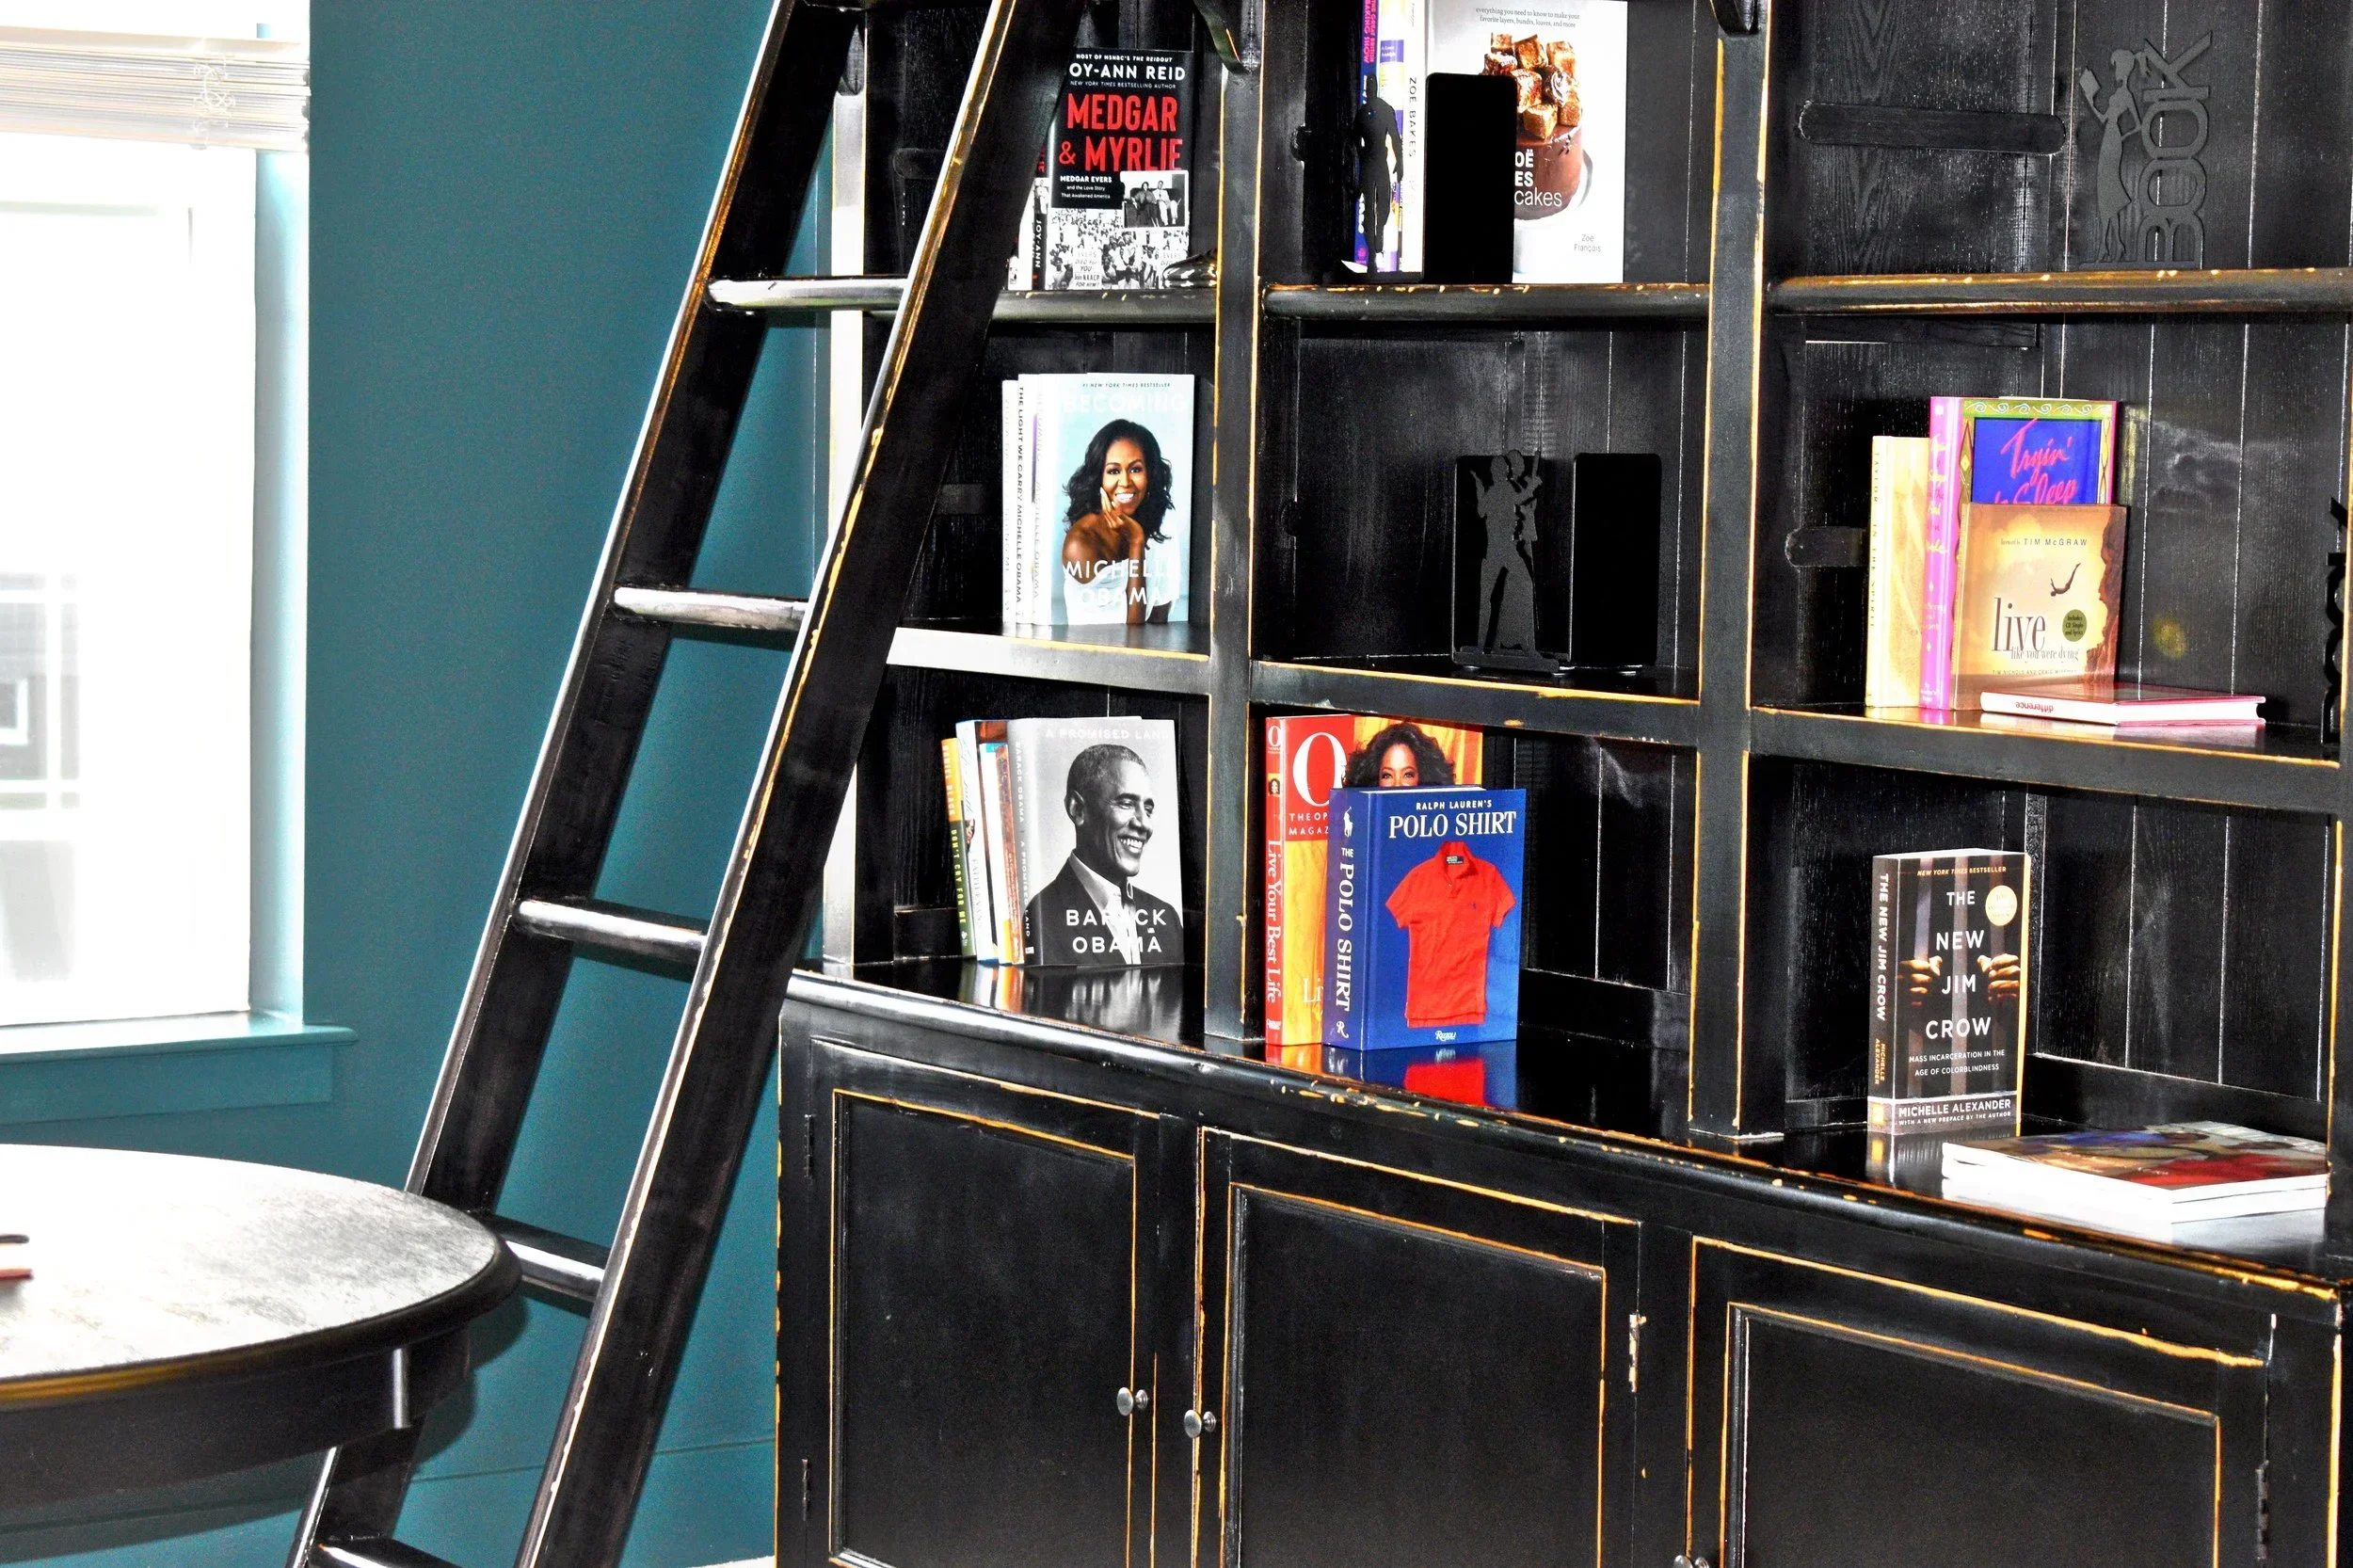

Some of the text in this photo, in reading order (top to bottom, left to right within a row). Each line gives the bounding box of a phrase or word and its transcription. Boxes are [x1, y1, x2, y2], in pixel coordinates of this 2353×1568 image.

[1476, 7, 1503, 15] everything
[1069, 63, 1186, 81] OY-ANN REID
[1066, 93, 1178, 132] MEDGAR
[1059, 141, 1076, 165] &
[1084, 136, 1183, 172] MYRLIE
[2137, 30, 2212, 264] BOOK
[1514, 149, 1534, 168] OË
[1513, 187, 1562, 207] cakes
[1017, 445, 1023, 461] WE
[2000, 417, 2073, 487] Tryin'
[1080, 586, 1161, 605] OBAMA
[1992, 597, 2046, 651] live
[2010, 646, 2080, 664] like you were dying
[2015, 701, 2054, 713] difference
[1045, 728, 1171, 740] A PROMISED LAND
[1268, 726, 1282, 747] O
[1292, 731, 1348, 808] O
[1416, 799, 1493, 810] RALPH LAUREN'S
[1289, 812, 1311, 822] THE
[1388, 810, 1517, 839] POLO SHIRT
[1289, 826, 1329, 836] MAGAZ
[951, 829, 960, 858] DON'T
[1268, 840, 1282, 877] Live
[1969, 866, 2007, 874] BESTSELLER
[956, 888, 965, 905] FOR
[1268, 880, 1283, 920] Your
[1945, 890, 1976, 906] THE
[959, 911, 967, 923] ME
[1065, 908, 1167, 926] BARCK
[1336, 847, 1354, 1012] THE POLO SHIRT
[1267, 924, 1281, 965] Best
[1877, 873, 1889, 1021] THE NEW JIM CROW
[1935, 929, 1985, 952] NEW
[1267, 968, 1282, 1004] Life
[1941, 973, 1977, 995] JIM
[1925, 1016, 1992, 1040] CROW
[1909, 1054, 1928, 1063] MASS
[1929, 1050, 1983, 1062] INCARCERATION
[1914, 1068, 1929, 1077] AGE
[1941, 1064, 2000, 1075] COLORBLINDNESS
[1898, 1098, 2011, 1118] MICHELLE ALEXANDER
